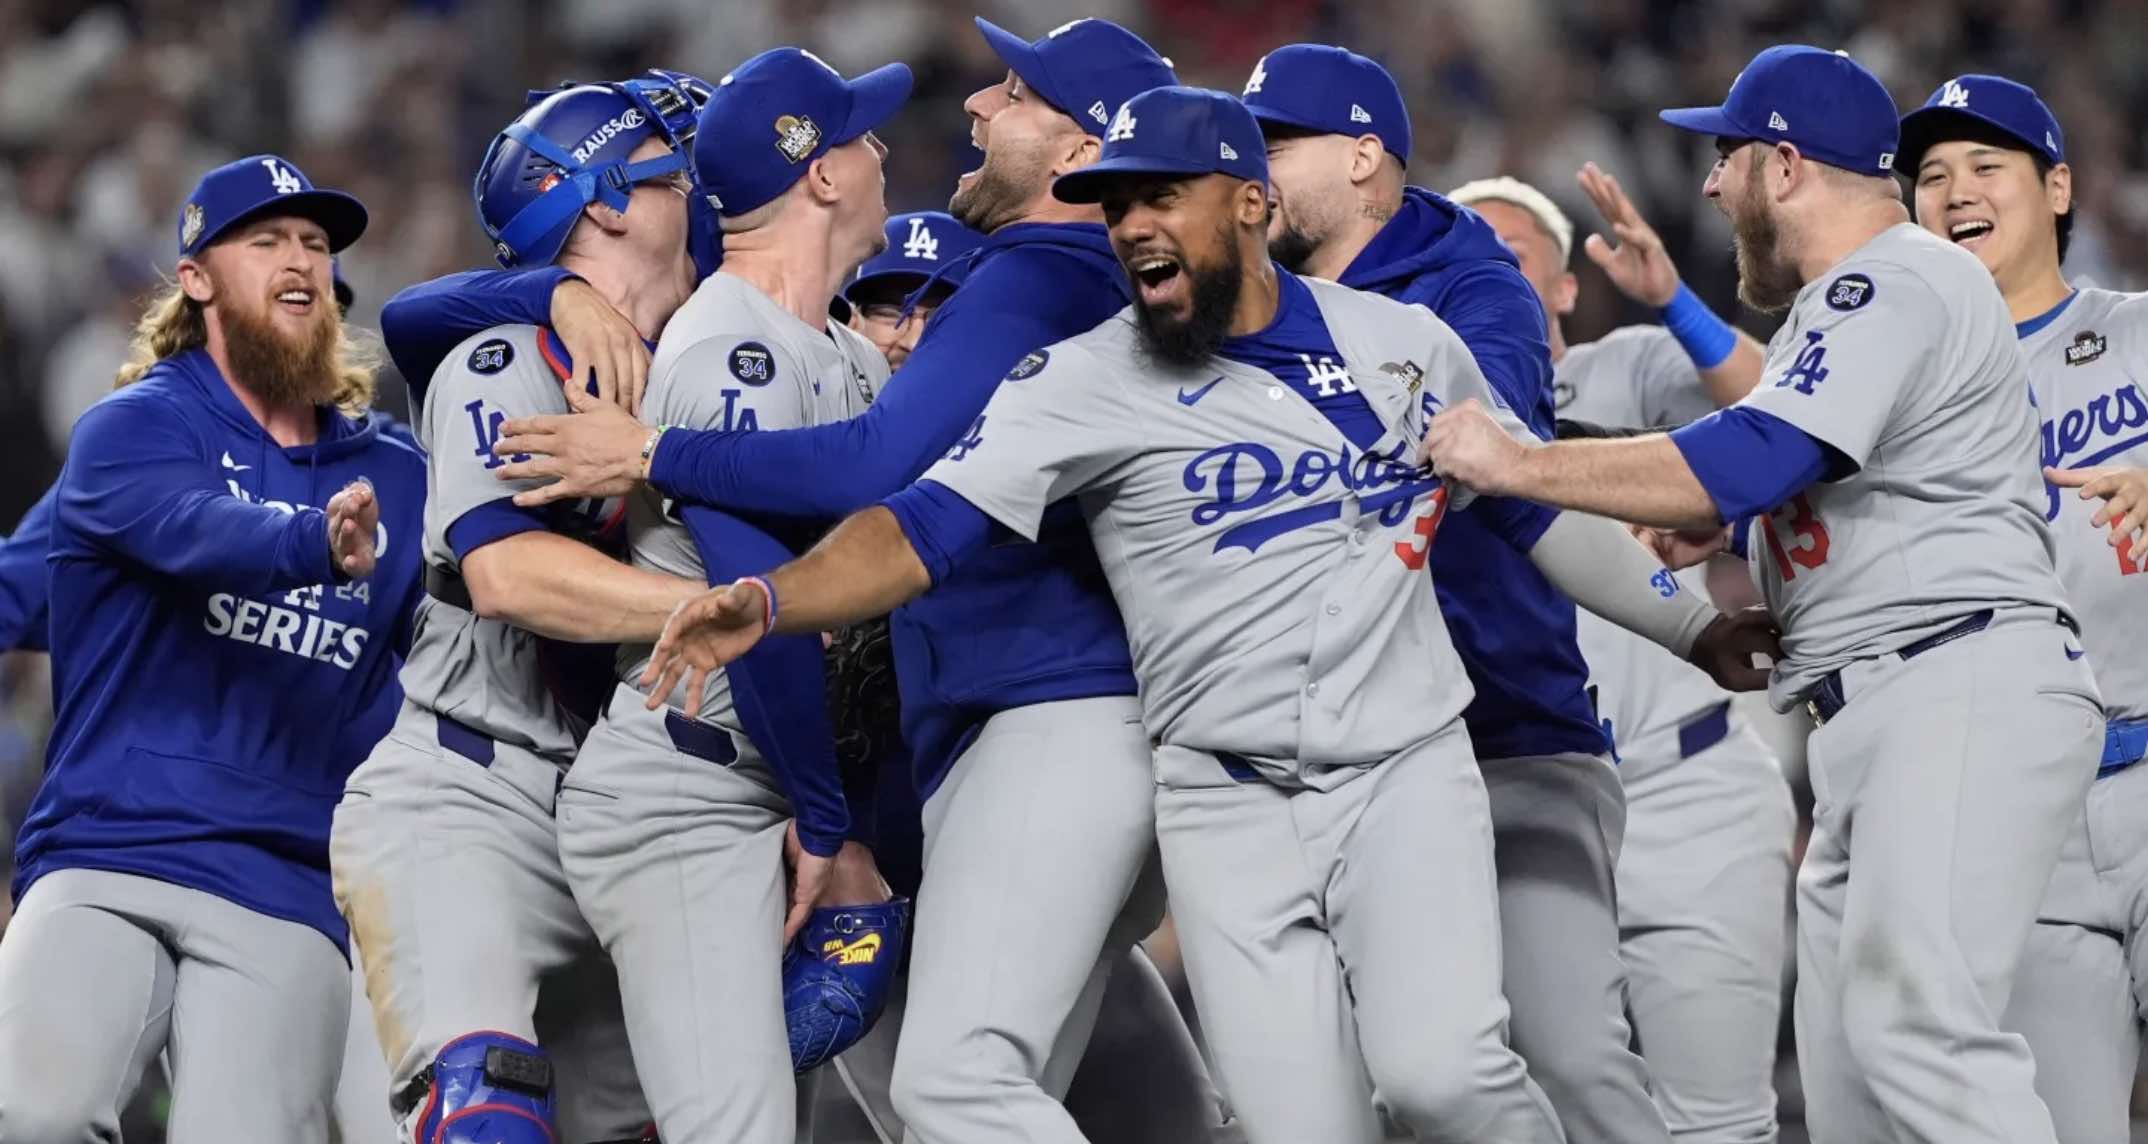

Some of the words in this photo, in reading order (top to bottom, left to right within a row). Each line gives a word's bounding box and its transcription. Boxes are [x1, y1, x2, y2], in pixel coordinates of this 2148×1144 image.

[1938, 79, 1969, 108] LA
[262, 159, 301, 193] LA
[903, 218, 938, 260] LA
[1831, 286, 1864, 306] 34
[475, 350, 504, 369] 34
[738, 358, 767, 380] 34
[1296, 353, 1358, 397] LA
[1776, 331, 1829, 396] LA
[1760, 490, 1830, 582] 13
[1651, 568, 1680, 597] 37
[203, 592, 369, 670] SERIES
[839, 946, 876, 965] NIKE
